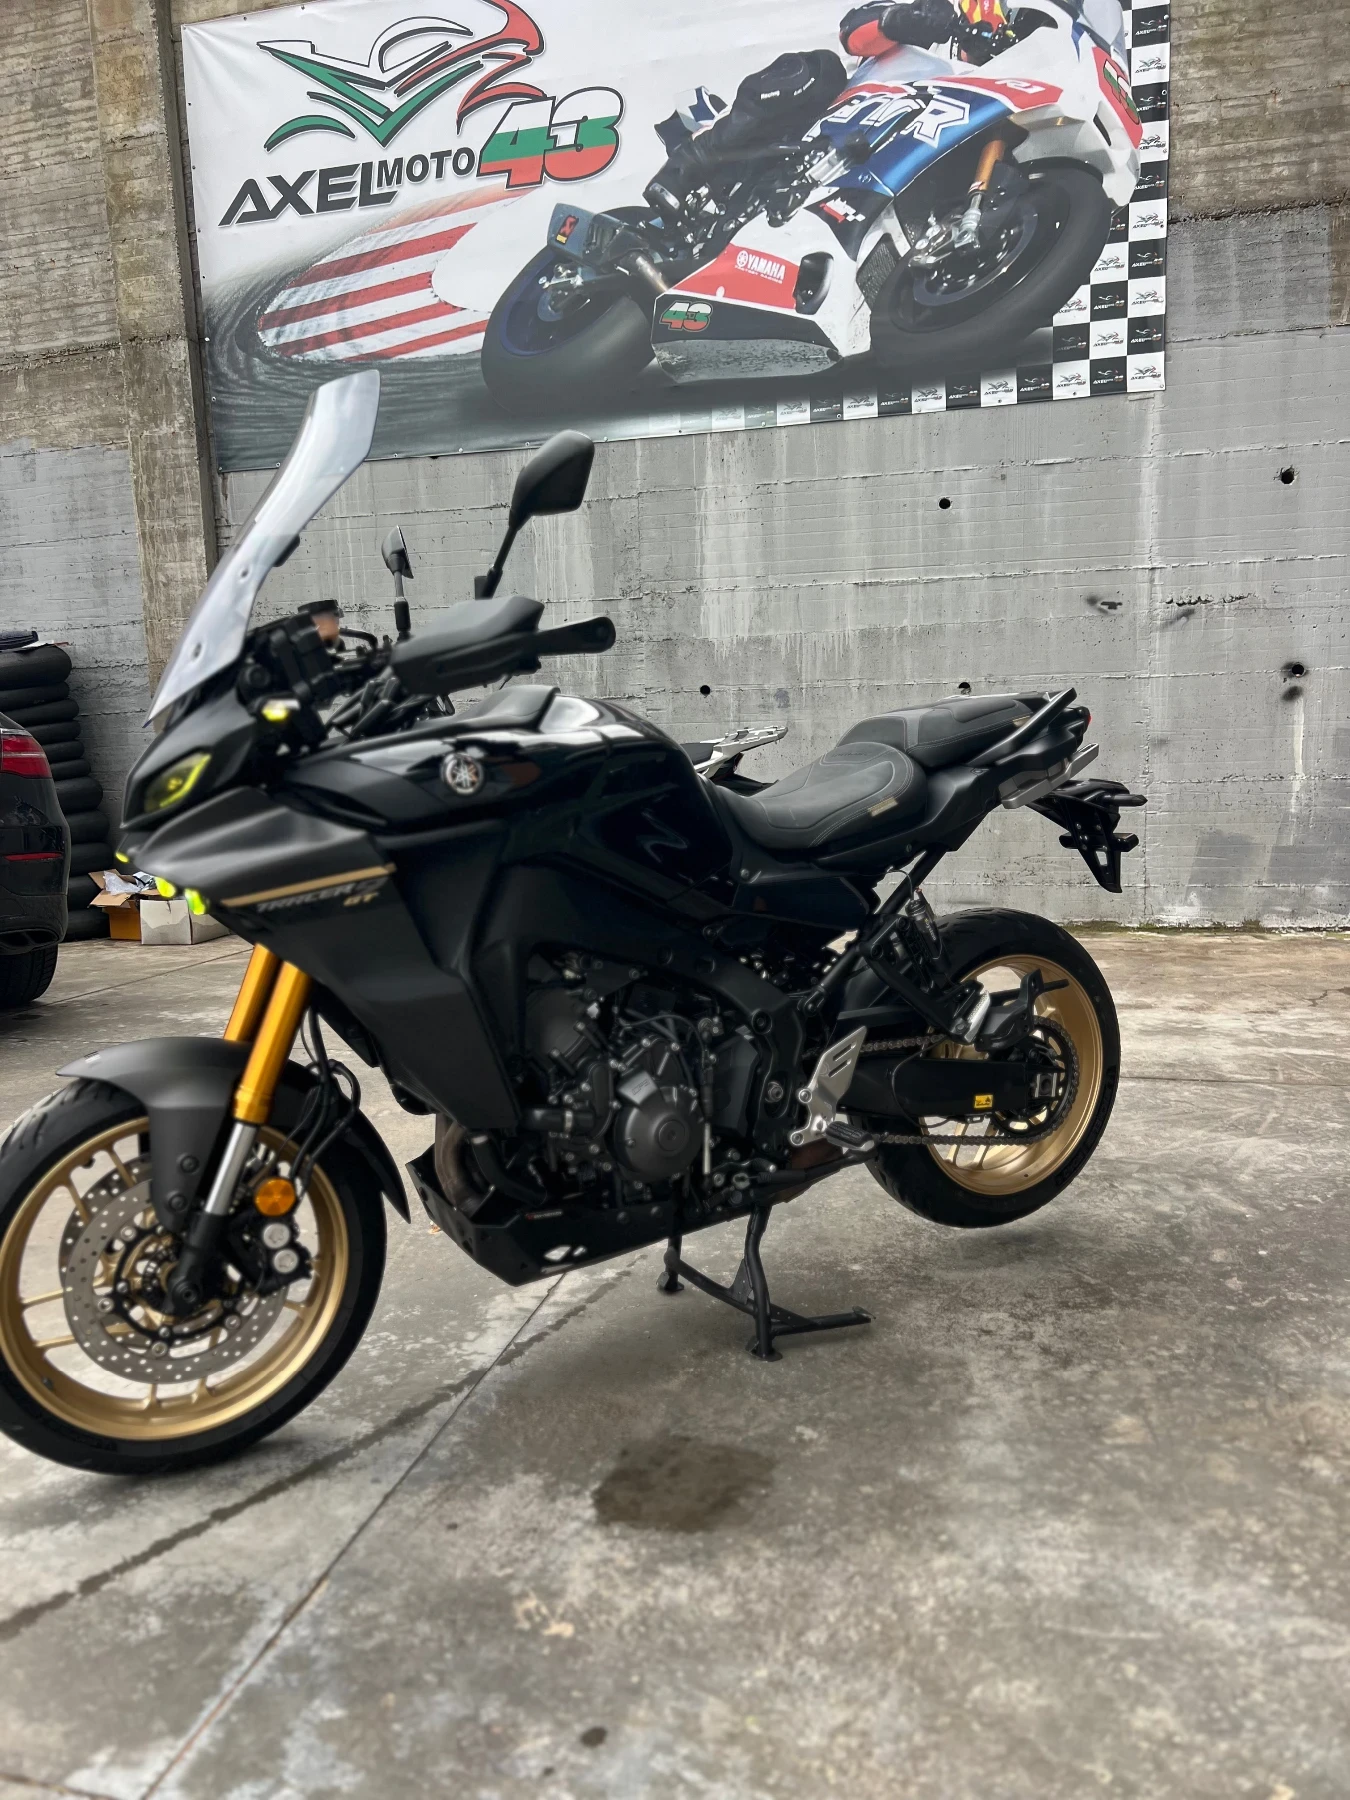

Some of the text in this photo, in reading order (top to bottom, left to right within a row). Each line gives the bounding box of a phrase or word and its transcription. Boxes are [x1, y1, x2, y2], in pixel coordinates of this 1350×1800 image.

[218, 86, 624, 226] AXEL MOTO 43
[747, 253, 786, 281] YAMAHA
[659, 300, 714, 332] 43
